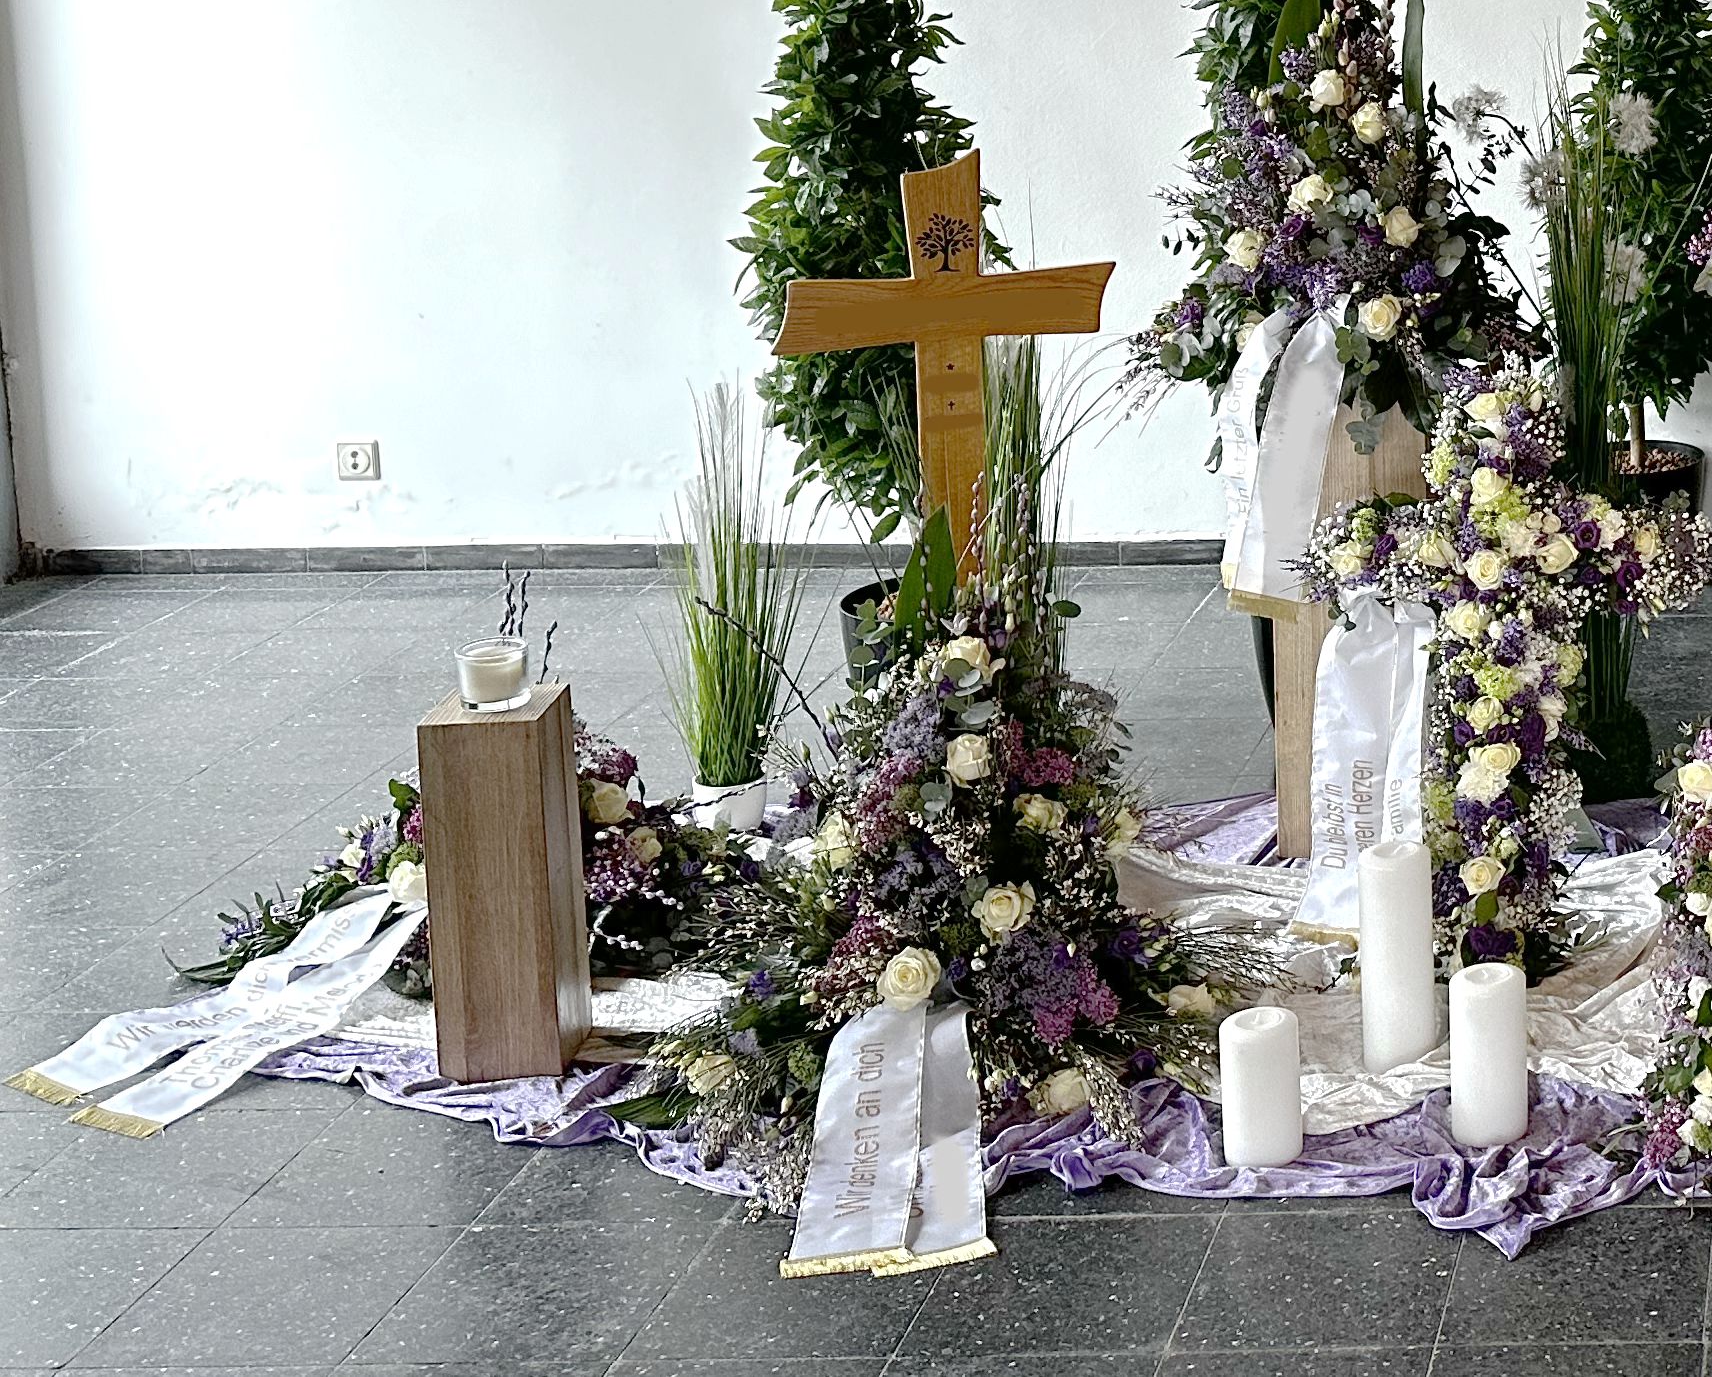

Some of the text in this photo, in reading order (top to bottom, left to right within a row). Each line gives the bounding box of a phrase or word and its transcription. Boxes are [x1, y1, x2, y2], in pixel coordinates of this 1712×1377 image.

[1227, 367, 1249, 414] Gruß
[1237, 486, 1251, 514] Ein
[1320, 796, 1348, 846] bleibst
[1346, 759, 1375, 853] eren Herzen
[1387, 778, 1405, 835] amilie
[1320, 846, 1348, 870] Du
[106, 1019, 156, 1052] Wir
[247, 961, 278, 1003] dich
[833, 1042, 885, 1220] Wir denken an dich
